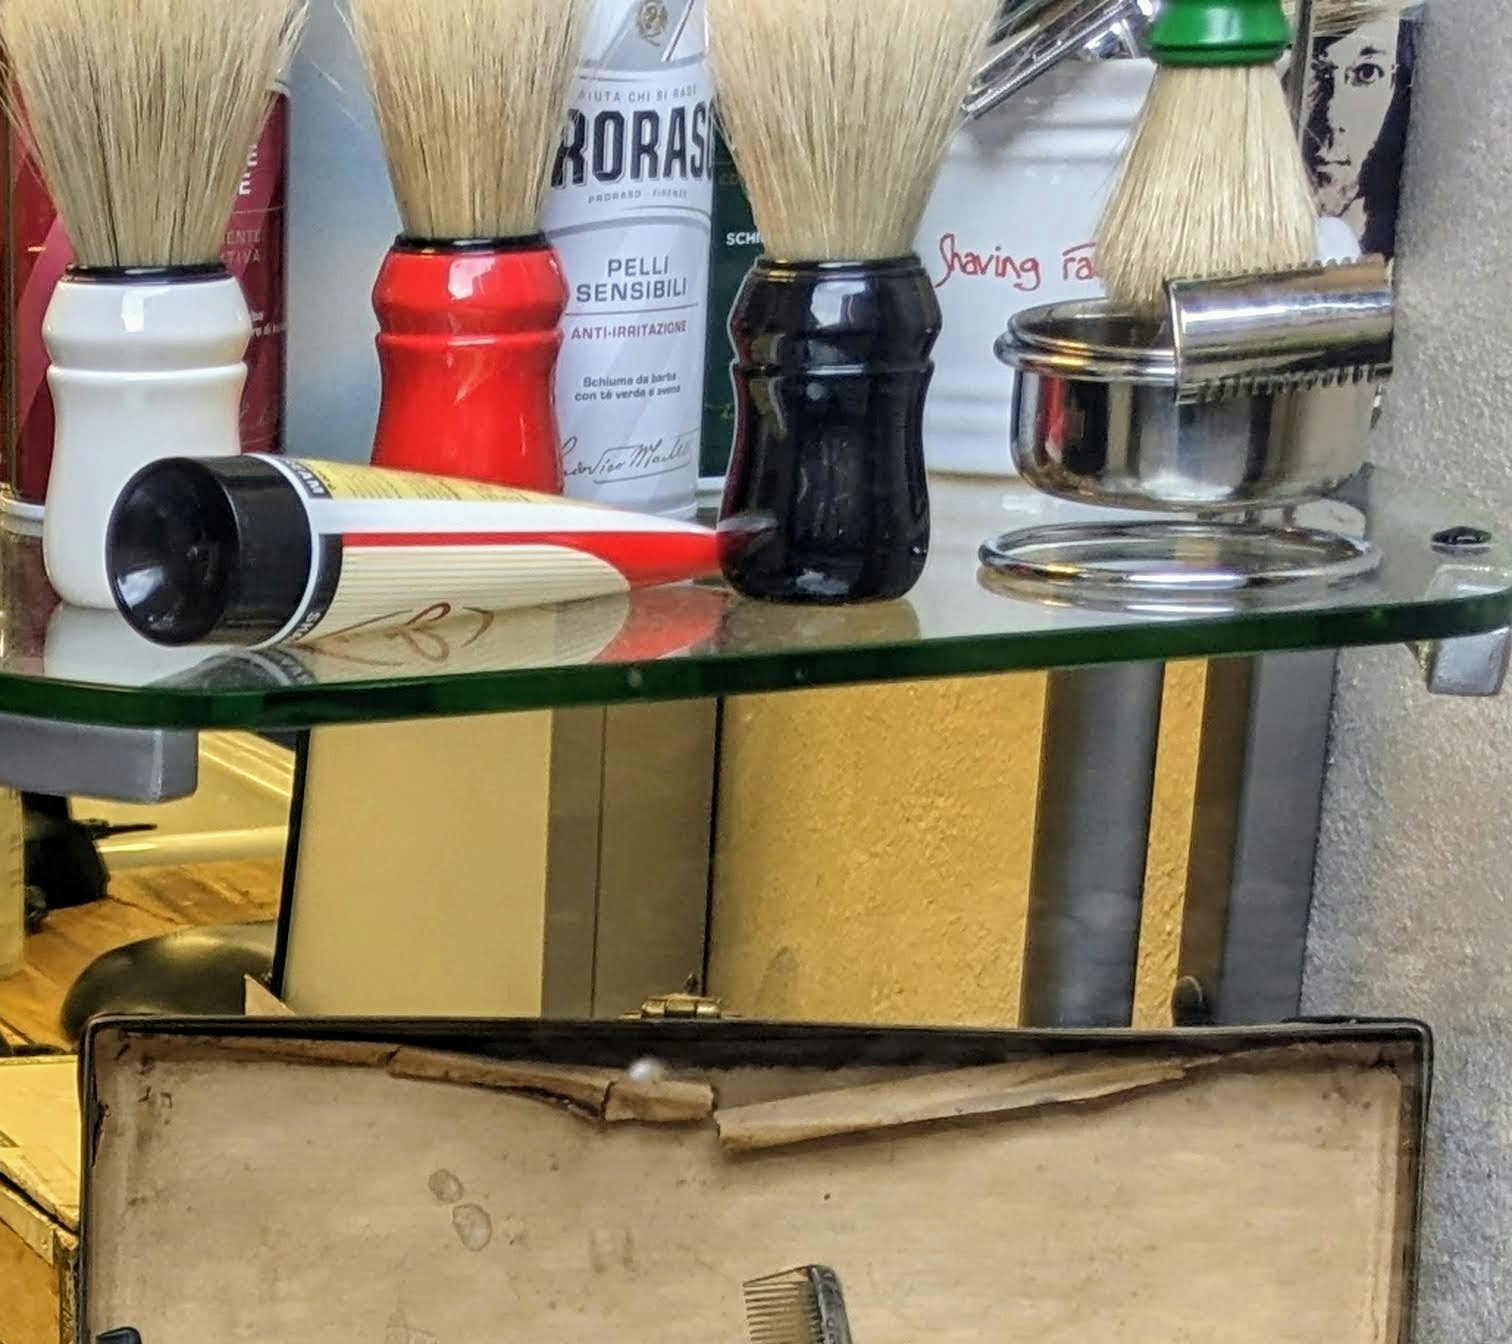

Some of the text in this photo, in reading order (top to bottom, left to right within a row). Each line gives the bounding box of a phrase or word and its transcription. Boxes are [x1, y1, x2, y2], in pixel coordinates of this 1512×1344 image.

[607, 256, 669, 277] PELLI
[934, 232, 1041, 291] Shaving
[576, 277, 687, 303] SENSIBILI
[571, 320, 688, 340] ANTI-IRRITAZIONE
